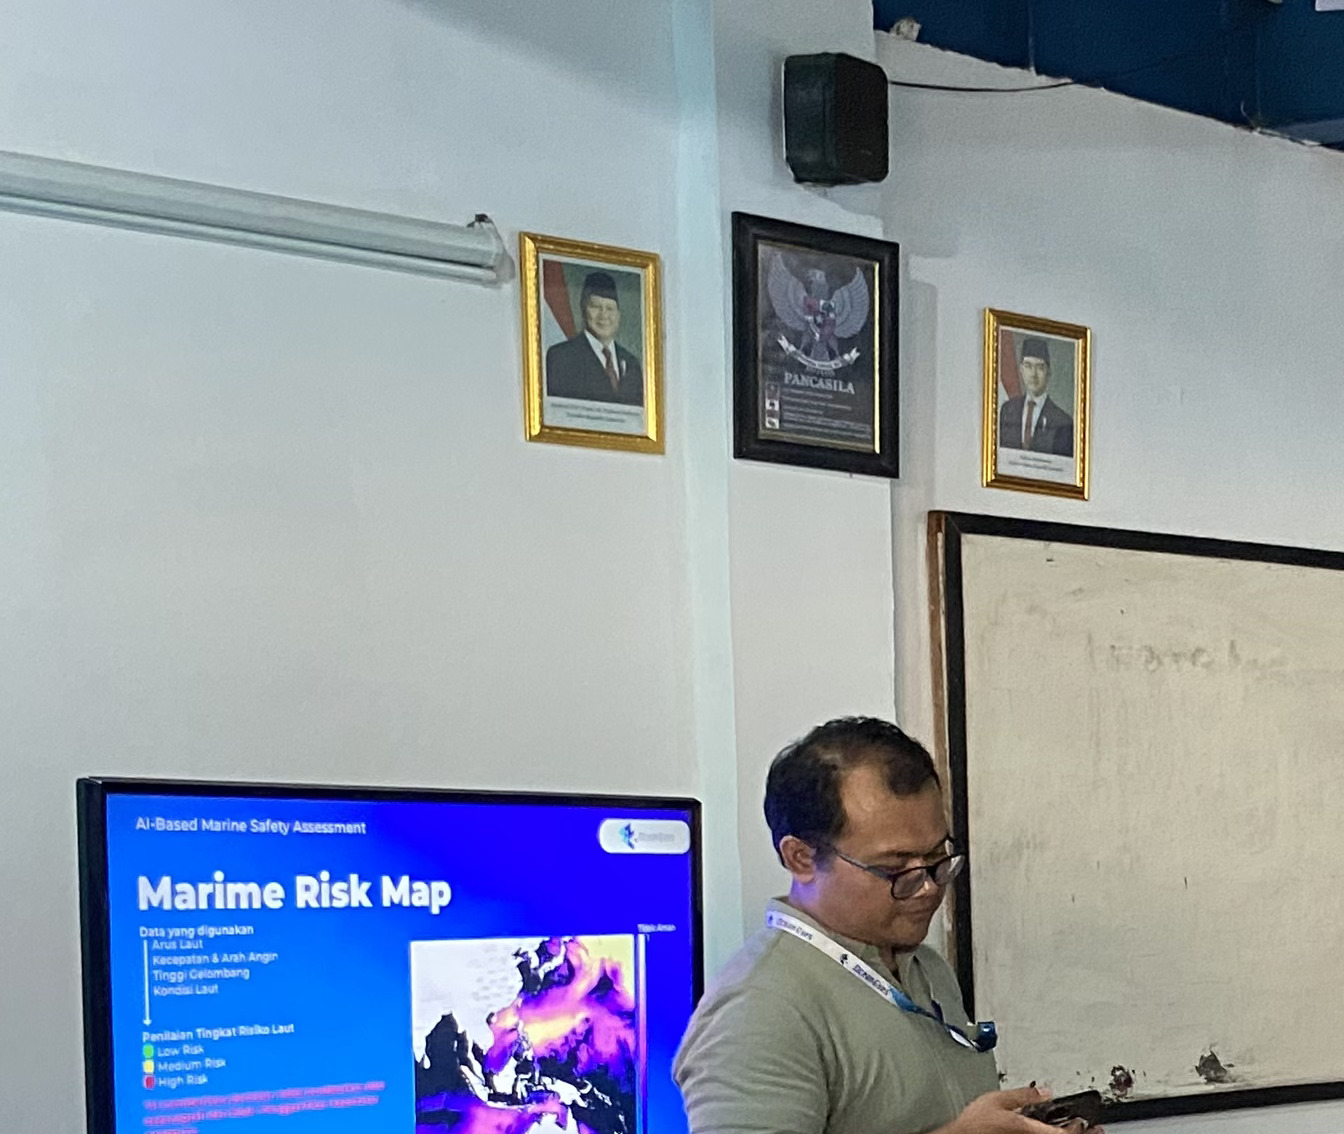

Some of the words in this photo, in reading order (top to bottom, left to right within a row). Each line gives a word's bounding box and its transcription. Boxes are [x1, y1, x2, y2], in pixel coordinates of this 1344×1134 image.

[784, 371, 855, 395] PANCASILA
[136, 817, 197, 831] AI-Based
[201, 819, 247, 832] Marine
[250, 819, 290, 835] Safety
[293, 820, 366, 834] Assessment
[138, 870, 285, 910] Marime
[296, 870, 373, 908] Risk
[381, 875, 451, 914] Map
[139, 926, 165, 937] Data
[168, 927, 195, 939] yang
[197, 925, 254, 938] digunakan
[152, 940, 177, 949] Arus
[179, 940, 203, 949] Laut
[152, 954, 209, 966] Kecepatan
[221, 952, 246, 963] Arah
[249, 952, 278, 964] Angin
[152, 969, 187, 983] Tinggi
[189, 968, 250, 980] Gelombang
[196, 984, 219, 994] Laut
[142, 1030, 193, 1042] Penilaian
[196, 1028, 237, 1041] Tingkat
[272, 1023, 295, 1034] Laut
[157, 1047, 179, 1057] Low
[182, 1045, 204, 1055] Risk
[158, 1060, 202, 1072] Medium
[205, 1057, 226, 1068] Risk
[159, 1076, 184, 1088] High
[187, 1074, 208, 1085] Risk
